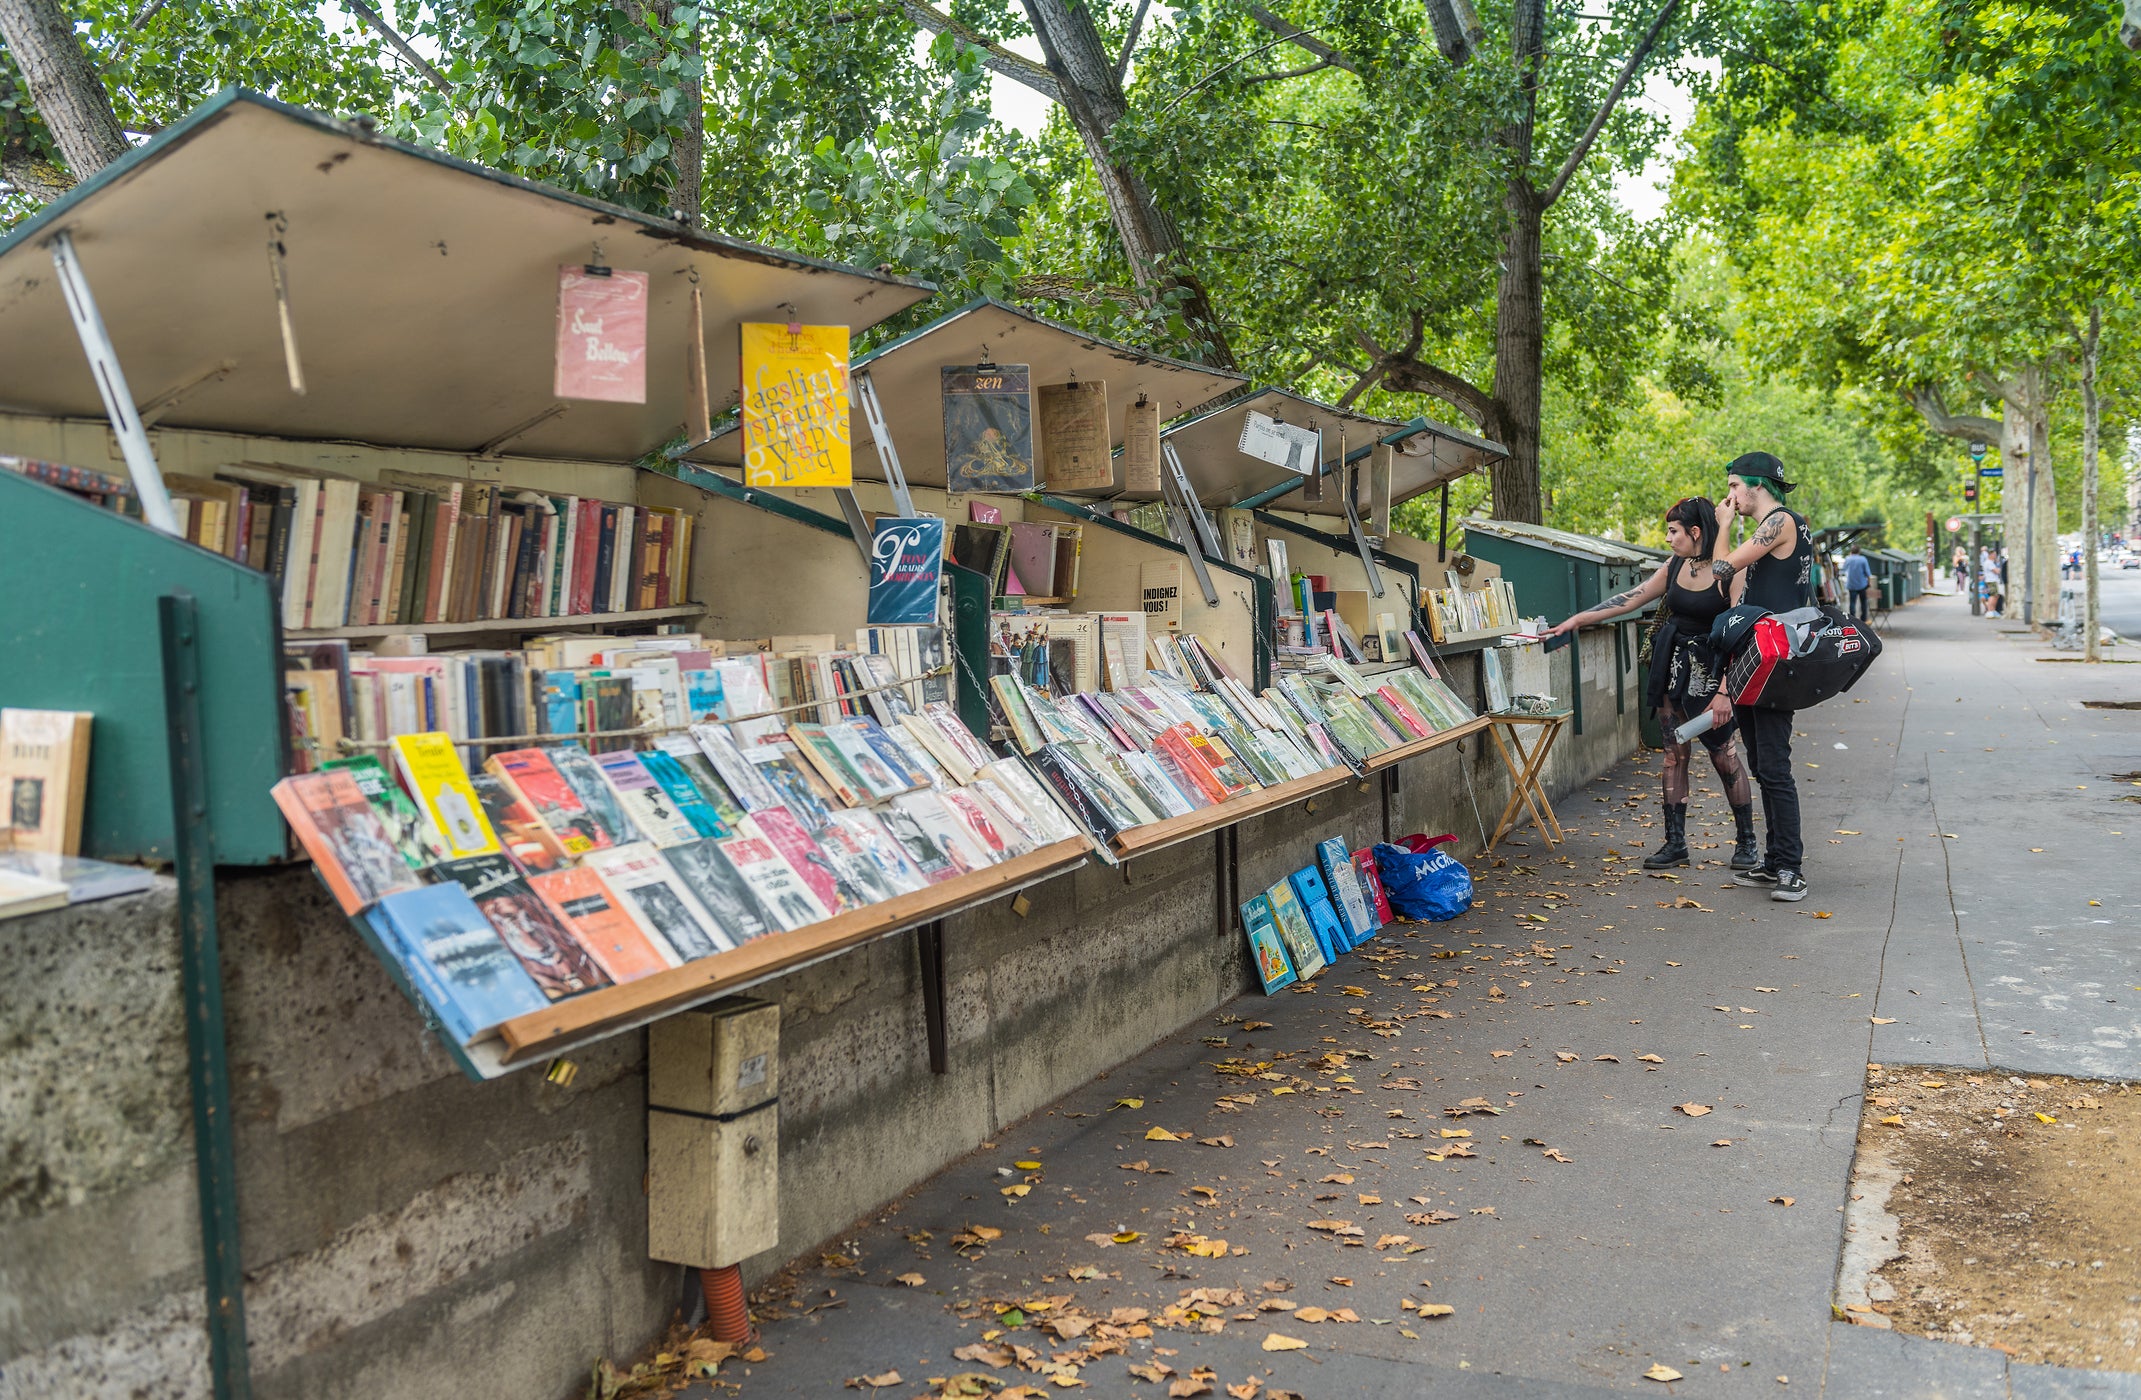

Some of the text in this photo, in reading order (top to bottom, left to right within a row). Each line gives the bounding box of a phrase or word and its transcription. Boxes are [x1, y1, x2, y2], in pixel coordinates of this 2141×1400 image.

[974, 377, 1003, 390] zen
[1971, 443, 1986, 452] BUS
[1143, 586, 1178, 600] INDIGNEZ
[1143, 600, 1164, 613] VOUS
